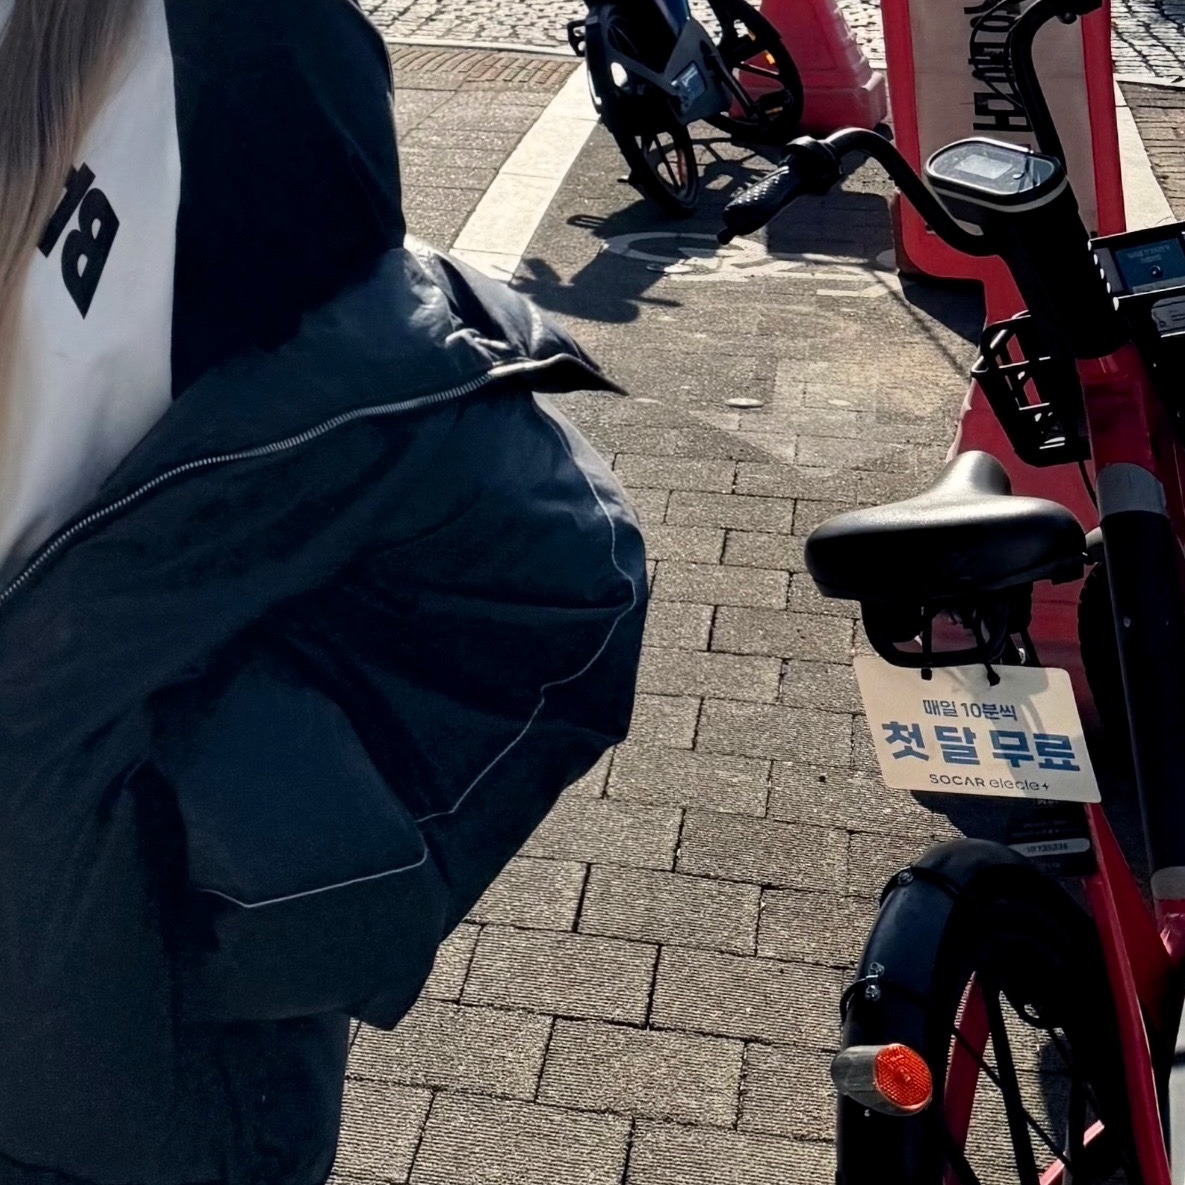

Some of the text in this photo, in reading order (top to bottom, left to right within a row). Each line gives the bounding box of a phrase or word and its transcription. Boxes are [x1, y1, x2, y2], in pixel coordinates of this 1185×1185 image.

[922, 699, 1018, 721] 매일 10분씩
[989, 730, 1081, 772] 무료
[929, 774, 985, 787] SOCAR
